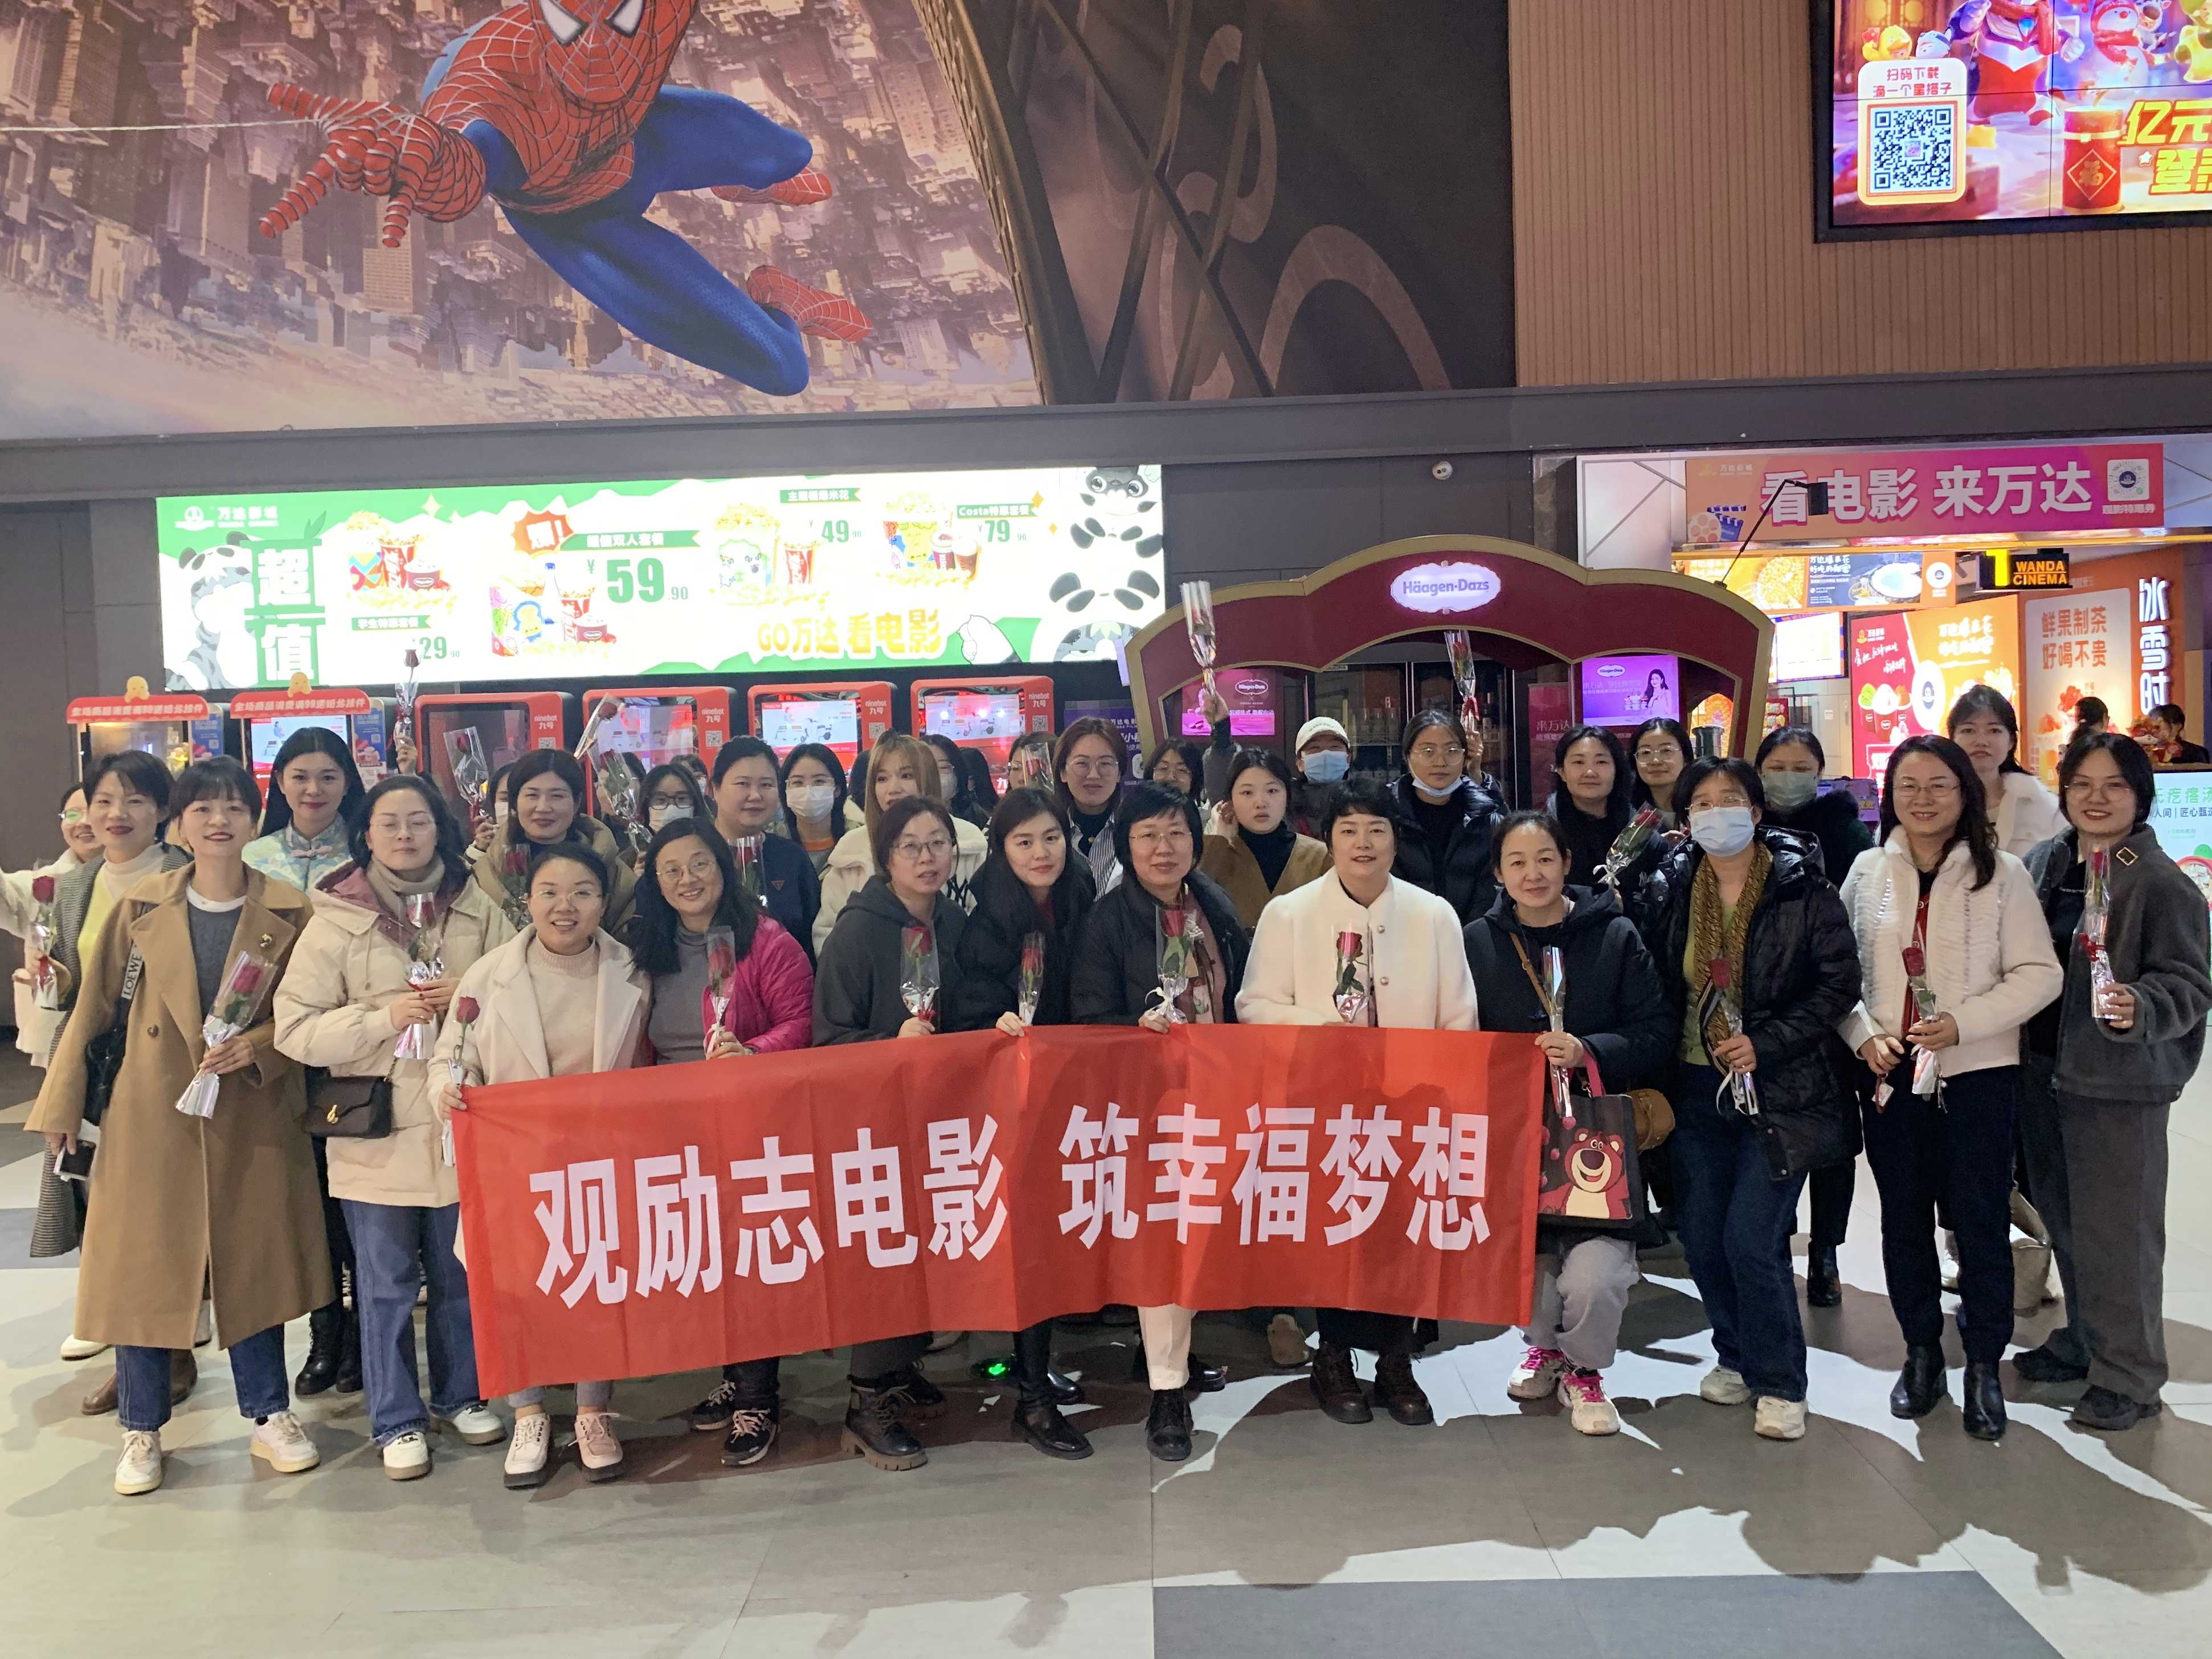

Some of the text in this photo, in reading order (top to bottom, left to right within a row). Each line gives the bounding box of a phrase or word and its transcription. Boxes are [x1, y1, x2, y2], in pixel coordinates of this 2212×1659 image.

[1886, 66, 1940, 81] 扫码下载
[2116, 100, 2212, 145] 亿元
[1761, 461, 2093, 523] 看电影 来万达
[821, 520, 849, 543] 49
[985, 519, 1010, 543] 79
[606, 557, 665, 603] 59
[2013, 573, 2067, 586] CINEMA
[2015, 560, 2064, 573] WANDA
[257, 548, 314, 681] 超值
[847, 608, 942, 654] 看电影
[2042, 605, 2107, 638] 鲜果制茶
[419, 636, 447, 659] 29
[2042, 639, 2107, 670] 好喝不贵
[123, 953, 142, 996] LOEWE
[529, 1102, 1493, 1309] 观励志电影 筑幸福梦想
